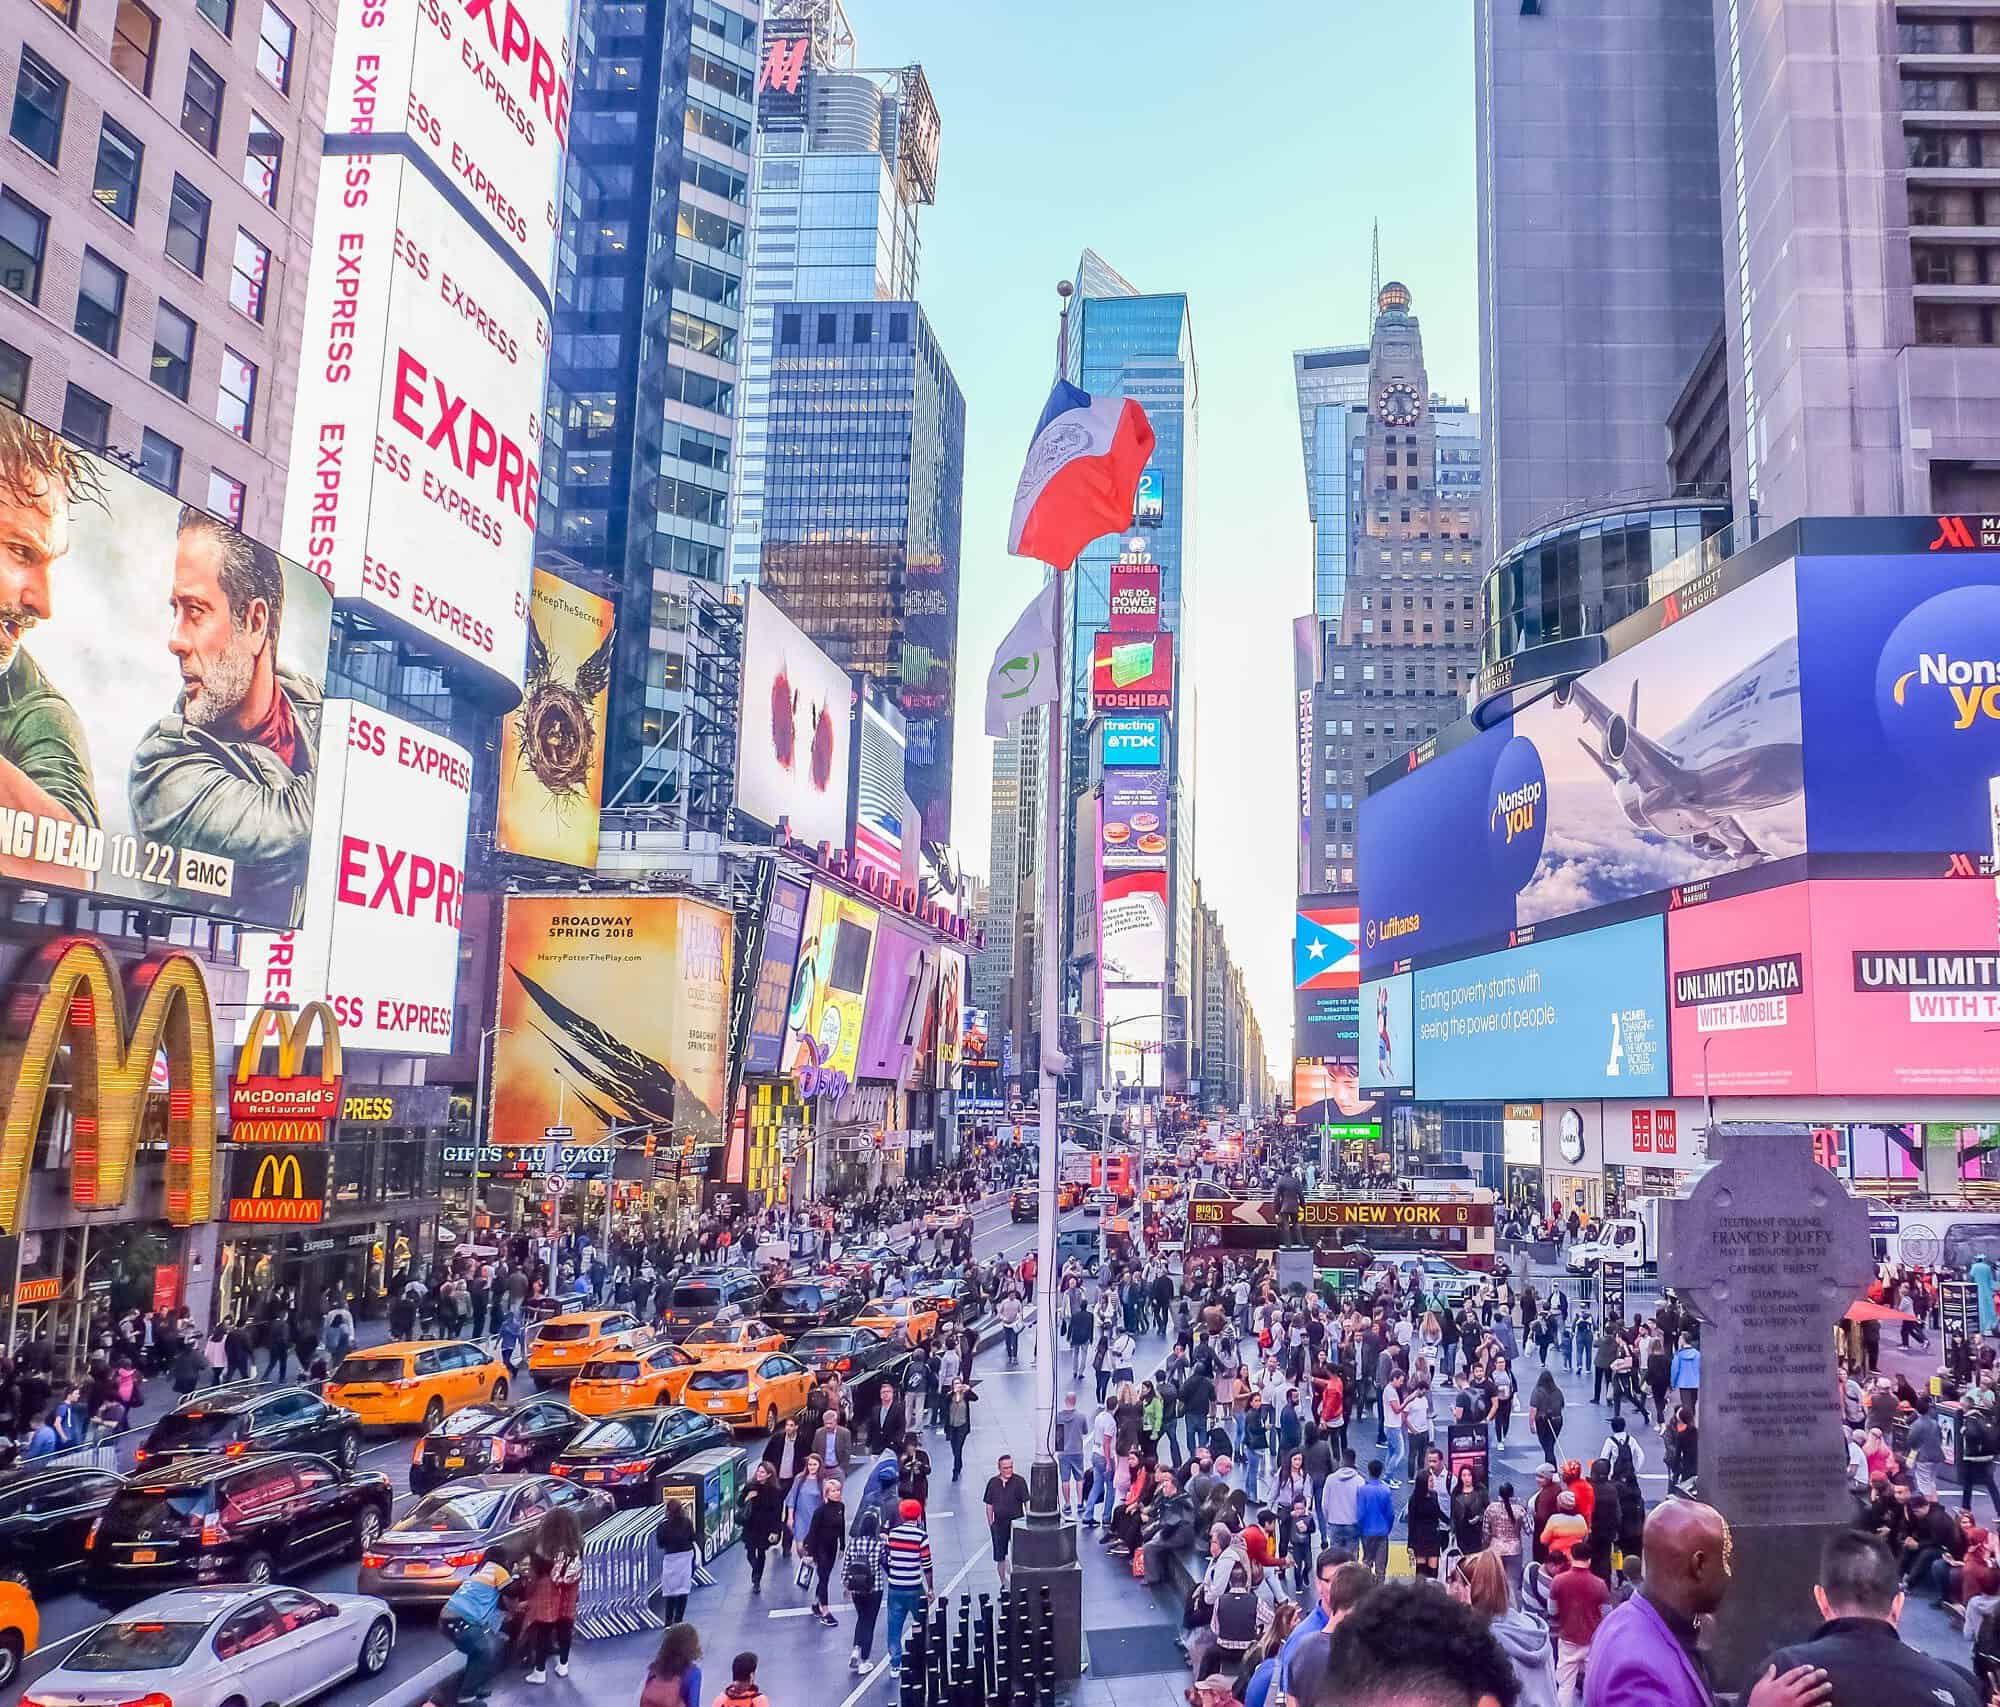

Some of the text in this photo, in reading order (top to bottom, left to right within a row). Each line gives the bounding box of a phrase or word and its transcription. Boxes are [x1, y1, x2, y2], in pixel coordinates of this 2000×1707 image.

[461, 37, 536, 148] EXPRESS
[344, 54, 381, 209] EXPRESS
[451, 141, 527, 243] EXPRESS
[326, 232, 364, 384] EXPRESS
[440, 273, 518, 365] EXPRESS
[307, 423, 345, 580] EXPRESS
[423, 470, 503, 548] EXPRESS
[1112, 565, 1159, 574] TOSHIBA
[1681, 567, 1722, 598] MARRIOTT
[1112, 597, 1157, 607] POWER
[1119, 589, 1150, 597] WE DO
[1681, 584, 1718, 613] MARQUIS
[412, 584, 495, 653] EXPRESS
[1112, 606, 1157, 615] STORAGE
[1095, 694, 1169, 707] TOSHIBA
[1119, 735, 1156, 748] TDK
[398, 736, 471, 795] EXPRESS
[1497, 781, 1542, 815] Nonstop
[1505, 804, 1533, 845] you
[34, 815, 106, 873] DEAD
[111, 833, 176, 886] 10.22
[548, 928, 634, 938] SPRING 2018
[551, 916, 633, 926] BROADWAY
[1379, 914, 1420, 941] Lufthansa
[537, 953, 642, 963] HarryPotterThePlay.com
[1420, 967, 1541, 1012] Ending poverty starts with
[1676, 960, 1799, 1002] UNLIMITED DATA
[376, 1000, 452, 1036] EXPRESS
[1700, 1000, 1785, 1027] WITH T-MOBILE
[1916, 995, 1978, 1017] WITH
[1420, 1018, 1449, 1042] seeing
[1450, 1015, 1465, 1036] the
[1467, 1014, 1500, 1041] power
[1501, 1009, 1512, 1030] of
[233, 1089, 335, 1104] McDonald's
[249, 1105, 316, 1114] Restaurant
[1657, 1115, 1673, 1131] UNI
[443, 1146, 616, 1163] GIFTS LUGAGE
[1657, 1133, 1675, 1150] QLO
[1345, 1206, 1385, 1223] NEW
[1393, 1206, 1441, 1223] YORK
[303, 1239, 335, 1252] EXPRESS
[1712, 1231, 1769, 1244] FRANCIS
[1786, 1230, 1833, 1244] DUFFY
[1783, 1264, 1819, 1273] PRIEST
